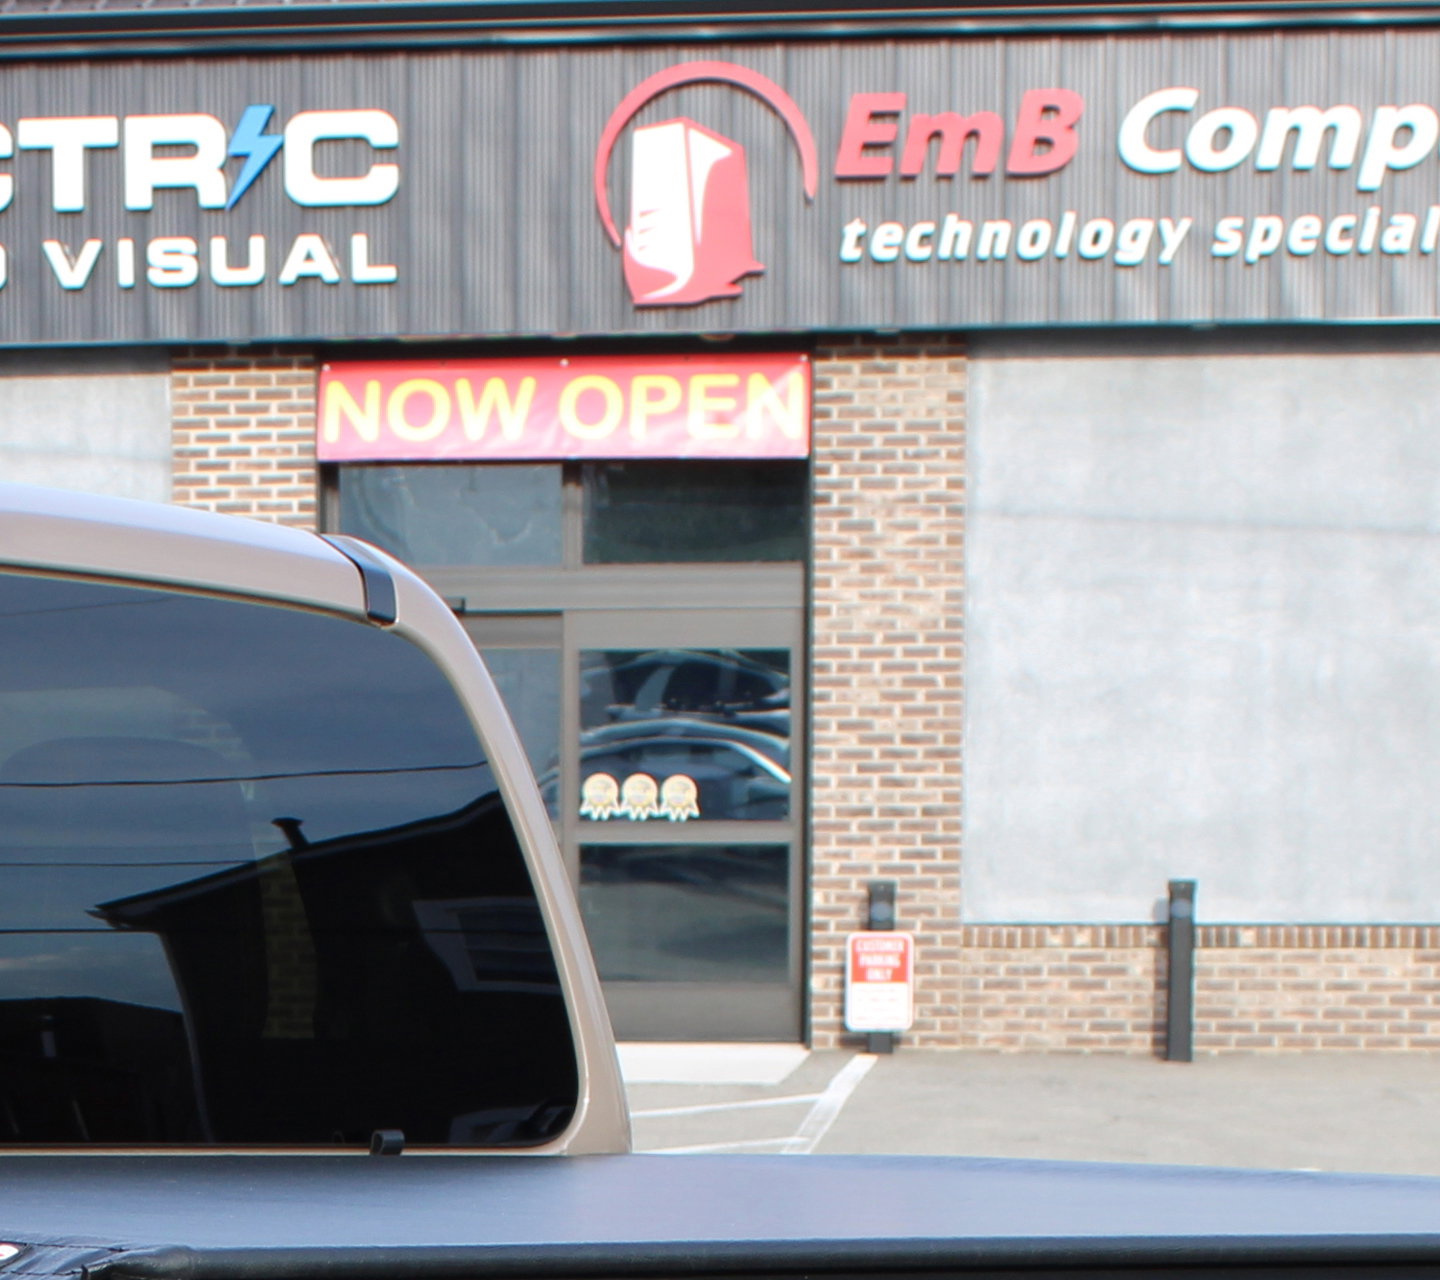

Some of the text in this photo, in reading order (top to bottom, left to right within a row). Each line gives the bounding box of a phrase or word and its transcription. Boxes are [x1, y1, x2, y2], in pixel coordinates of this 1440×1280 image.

[832, 86, 1085, 182] EmB
[42, 233, 400, 291] VISUAL
[839, 208, 1193, 266] technology
[323, 371, 806, 444] NOW OPEN
